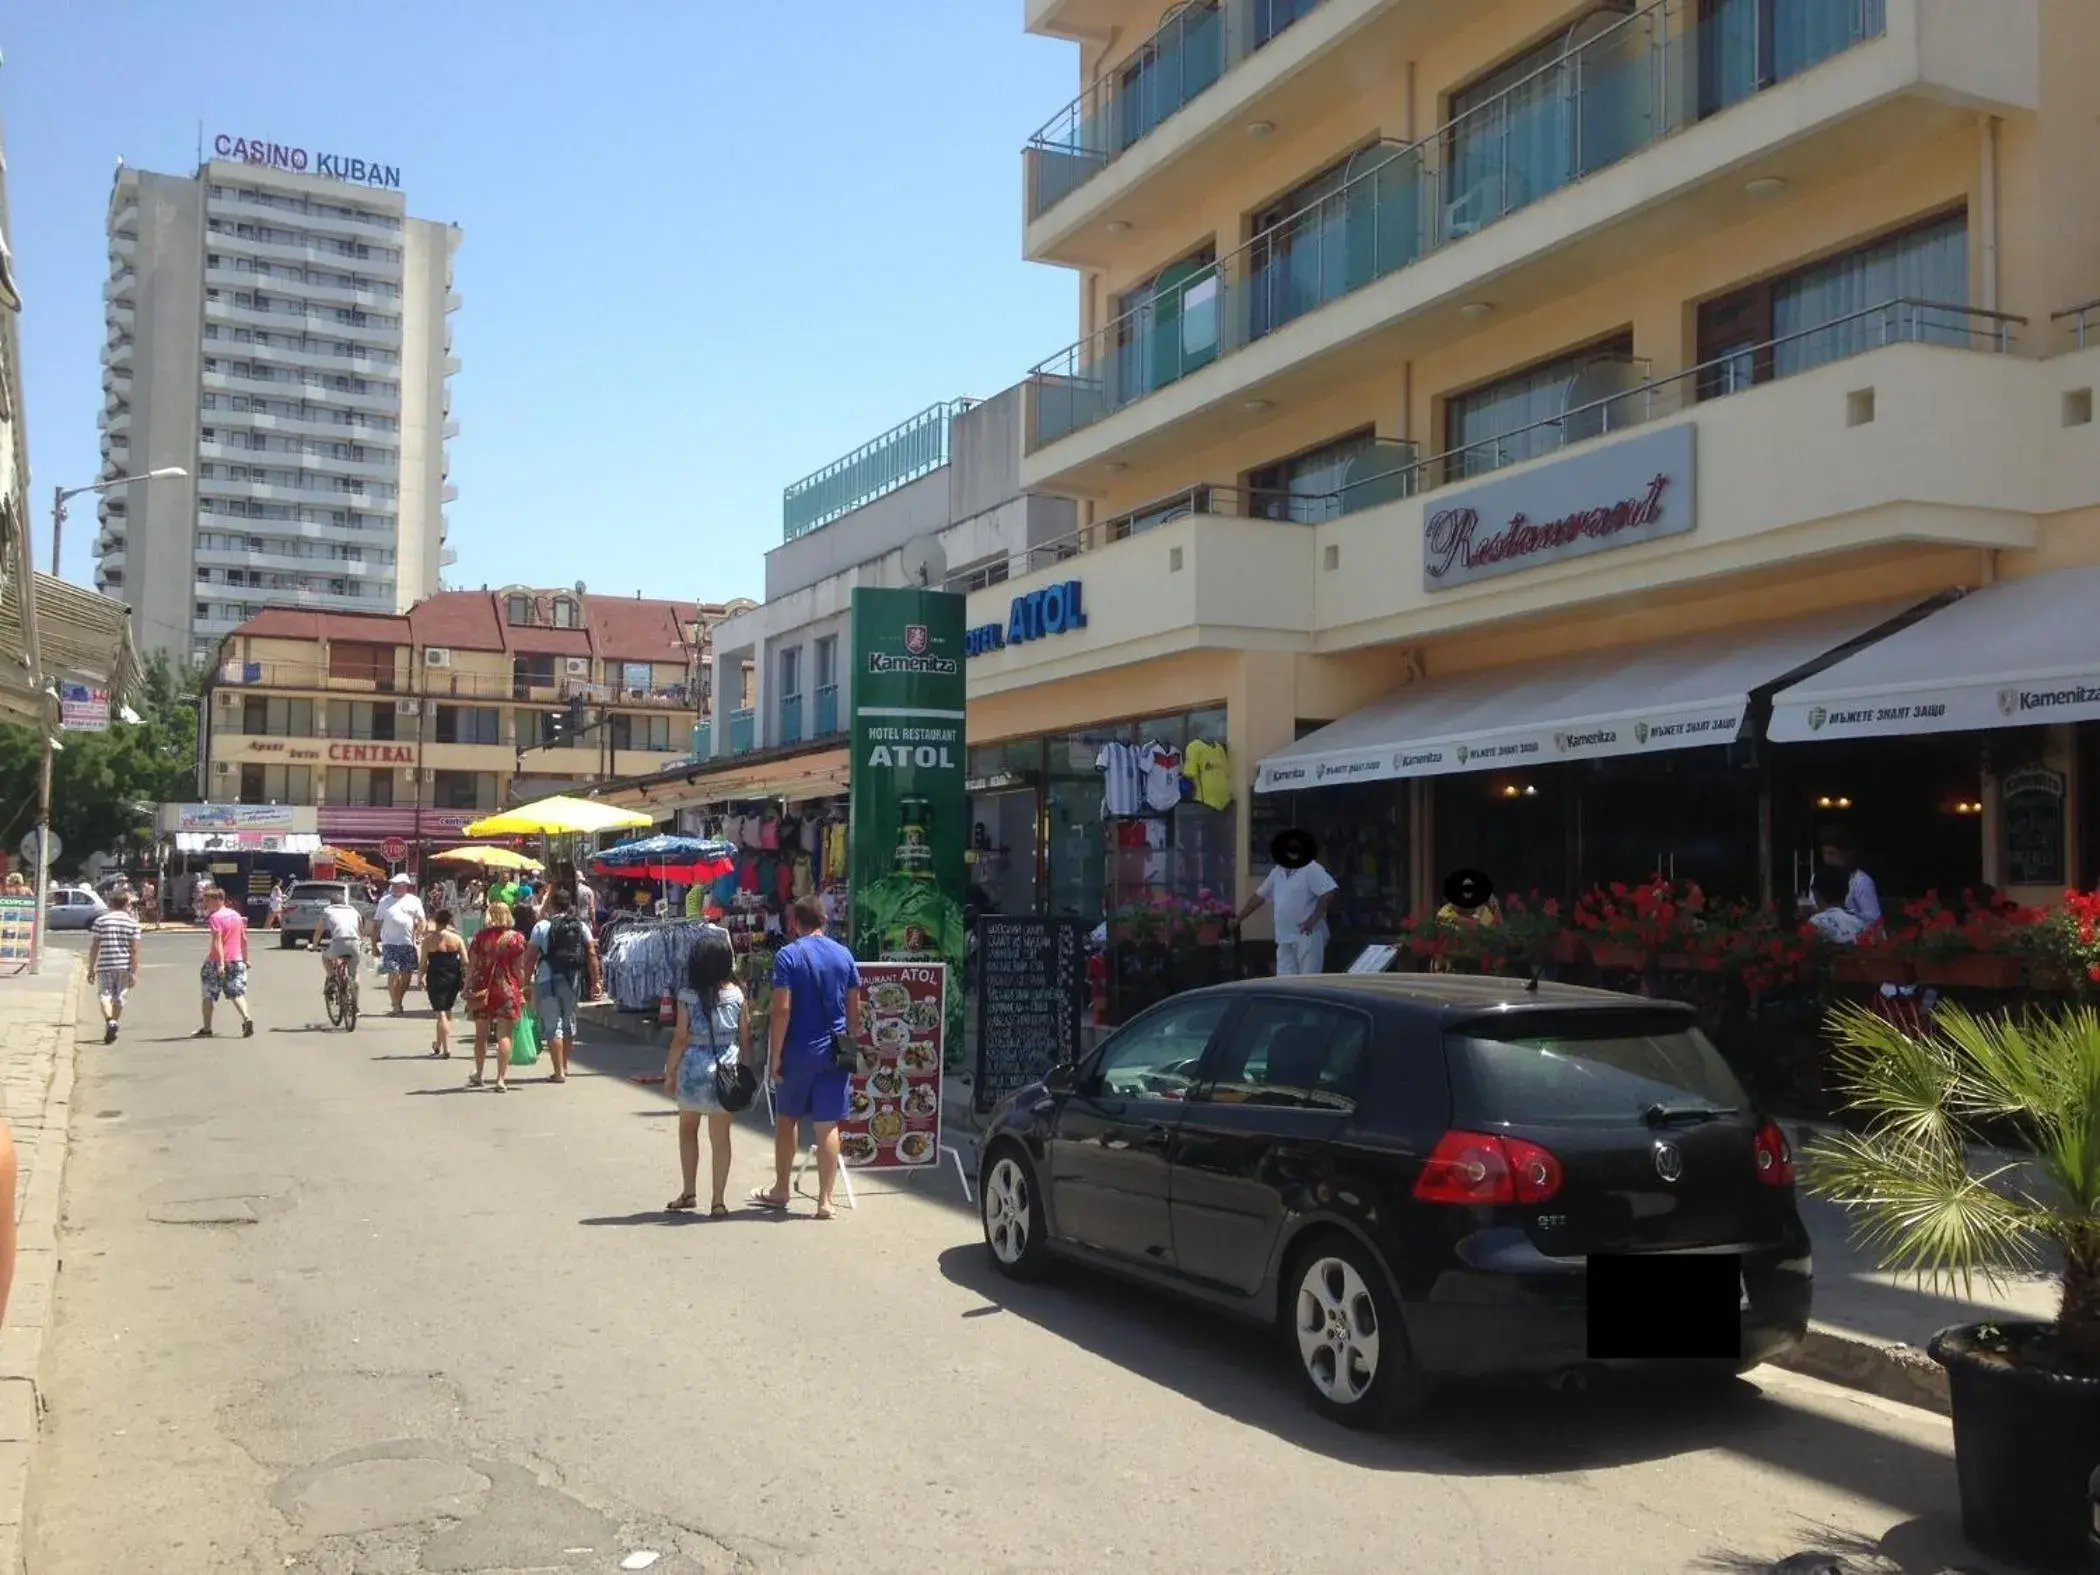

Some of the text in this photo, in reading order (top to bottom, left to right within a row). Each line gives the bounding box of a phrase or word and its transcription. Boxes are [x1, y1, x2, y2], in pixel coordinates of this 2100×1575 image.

[215, 134, 401, 187] CASINO KUBAN
[1425, 472, 1671, 577] Restaurant
[964, 580, 1088, 658] OTEL ATOL
[869, 652, 957, 674] Kamenitza
[869, 727, 956, 742] HOTEL RESTAURANT
[1566, 731, 1617, 748] Kamenitza
[328, 744, 415, 763] CENTRAL
[868, 745, 956, 769] ATOL
[1402, 752, 1443, 767] Kamenitza
[383, 845, 407, 854] STOP
[900, 967, 938, 986] ATOL
